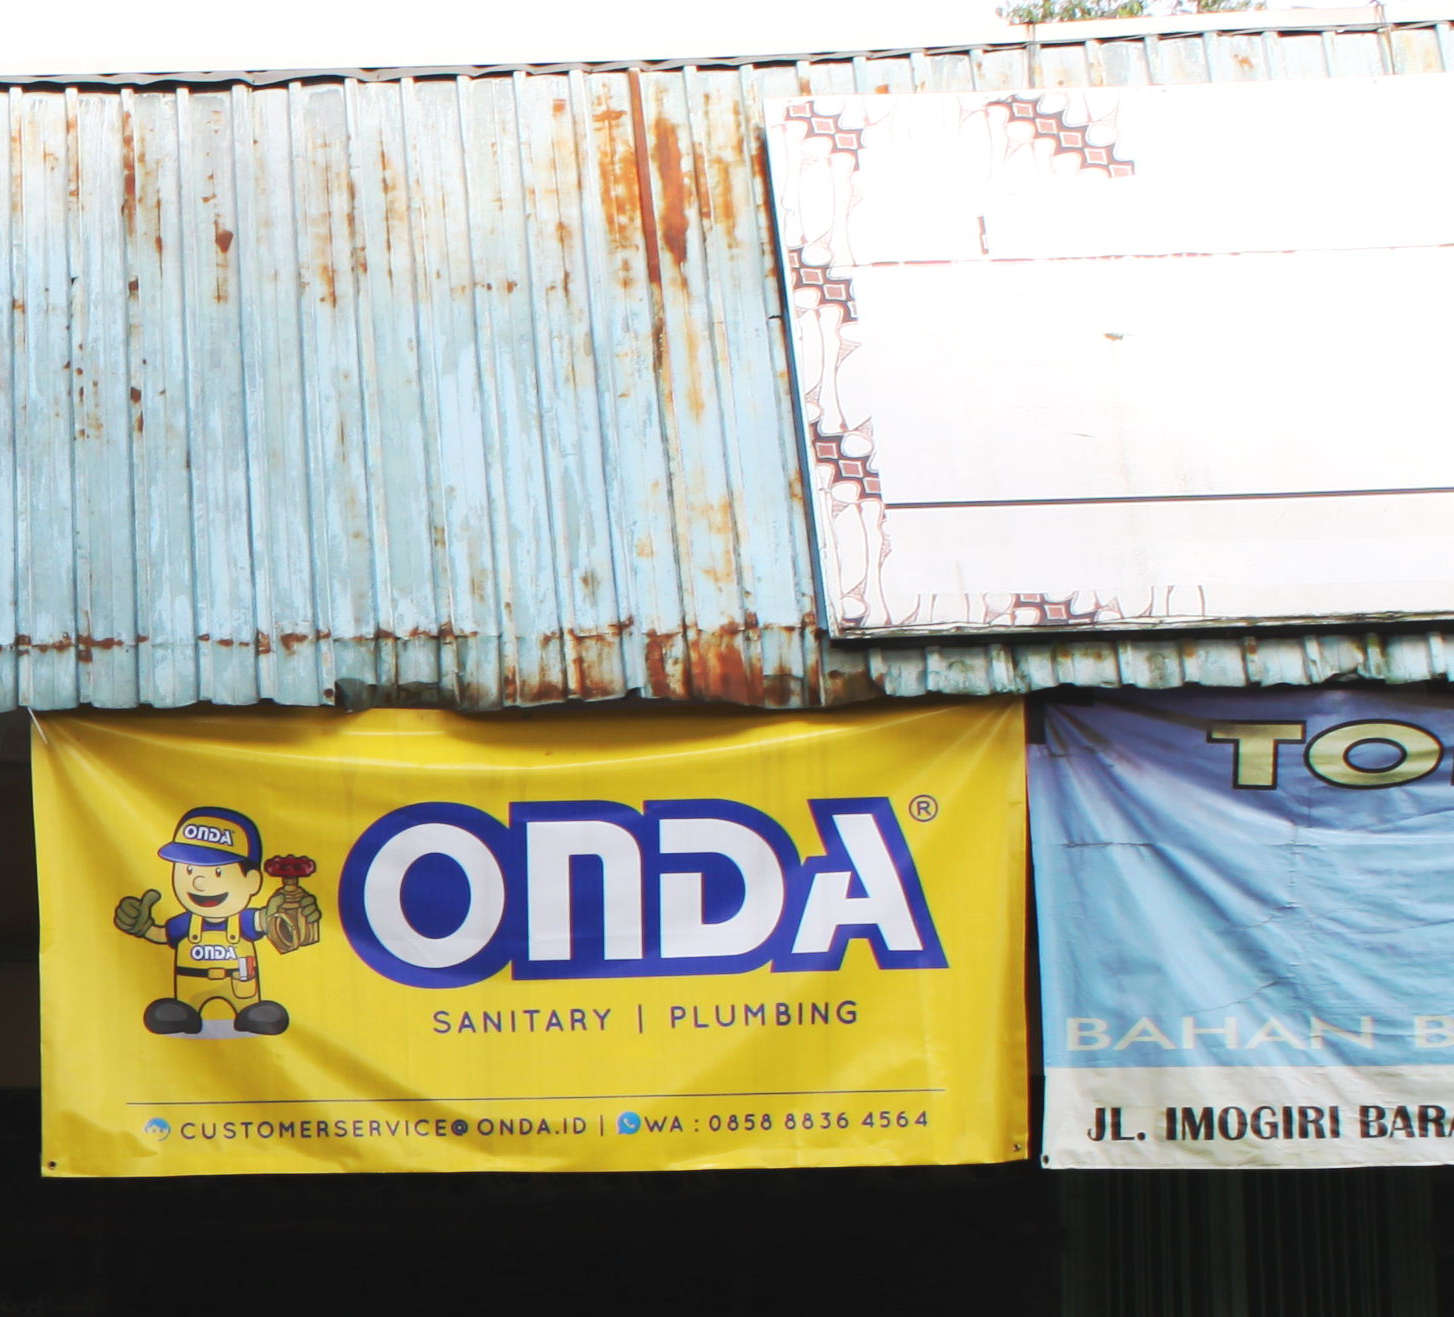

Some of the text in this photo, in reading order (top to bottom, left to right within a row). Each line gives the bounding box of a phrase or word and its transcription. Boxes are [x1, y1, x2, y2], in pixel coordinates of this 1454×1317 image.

[1207, 720, 1454, 790] TO
[432, 1000, 859, 1034] SANITARY PLUMBING
[1066, 1014, 1375, 1052] BAHAN
[645, 1115, 684, 1133] WA
[708, 1113, 773, 1132] 0858
[784, 1112, 850, 1130] 8836
[861, 1110, 928, 1129] 4564
[1087, 1104, 1454, 1142] JL. IMOGIRI BAR
